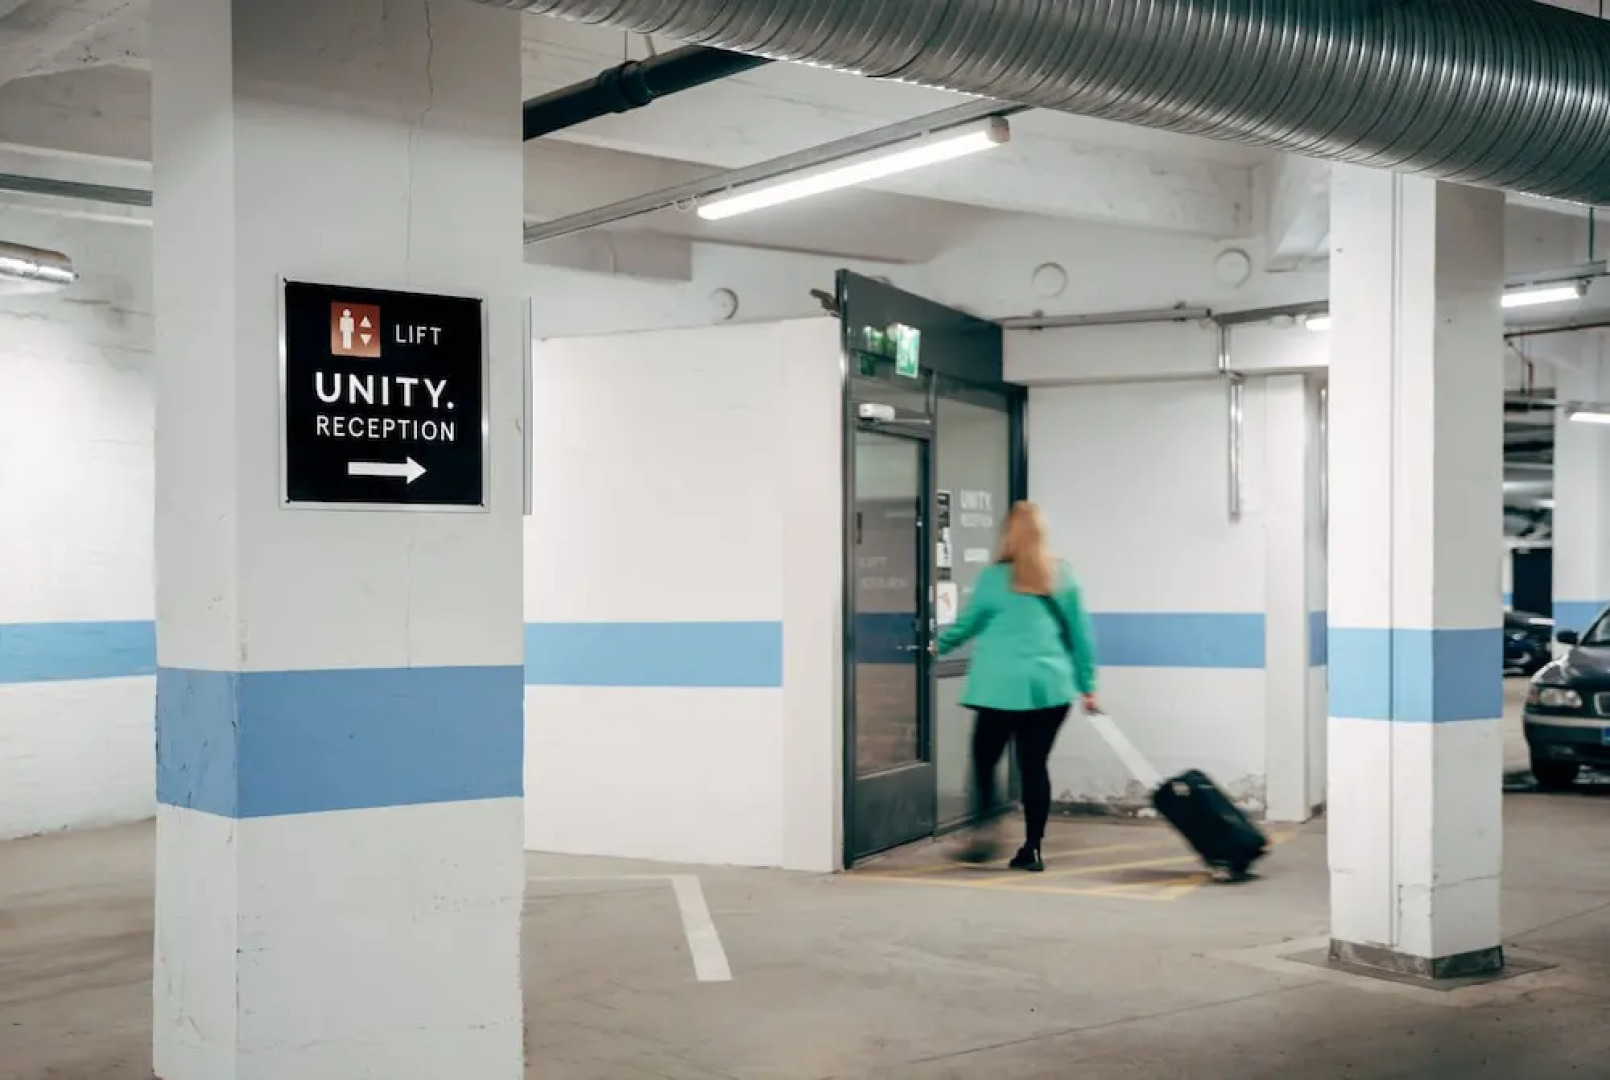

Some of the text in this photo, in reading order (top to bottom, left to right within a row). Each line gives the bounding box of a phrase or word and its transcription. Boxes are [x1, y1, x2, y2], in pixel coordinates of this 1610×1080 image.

[395, 324, 442, 345] LIFT
[315, 371, 455, 410] UNITY.
[316, 414, 455, 442] RECEPTION
